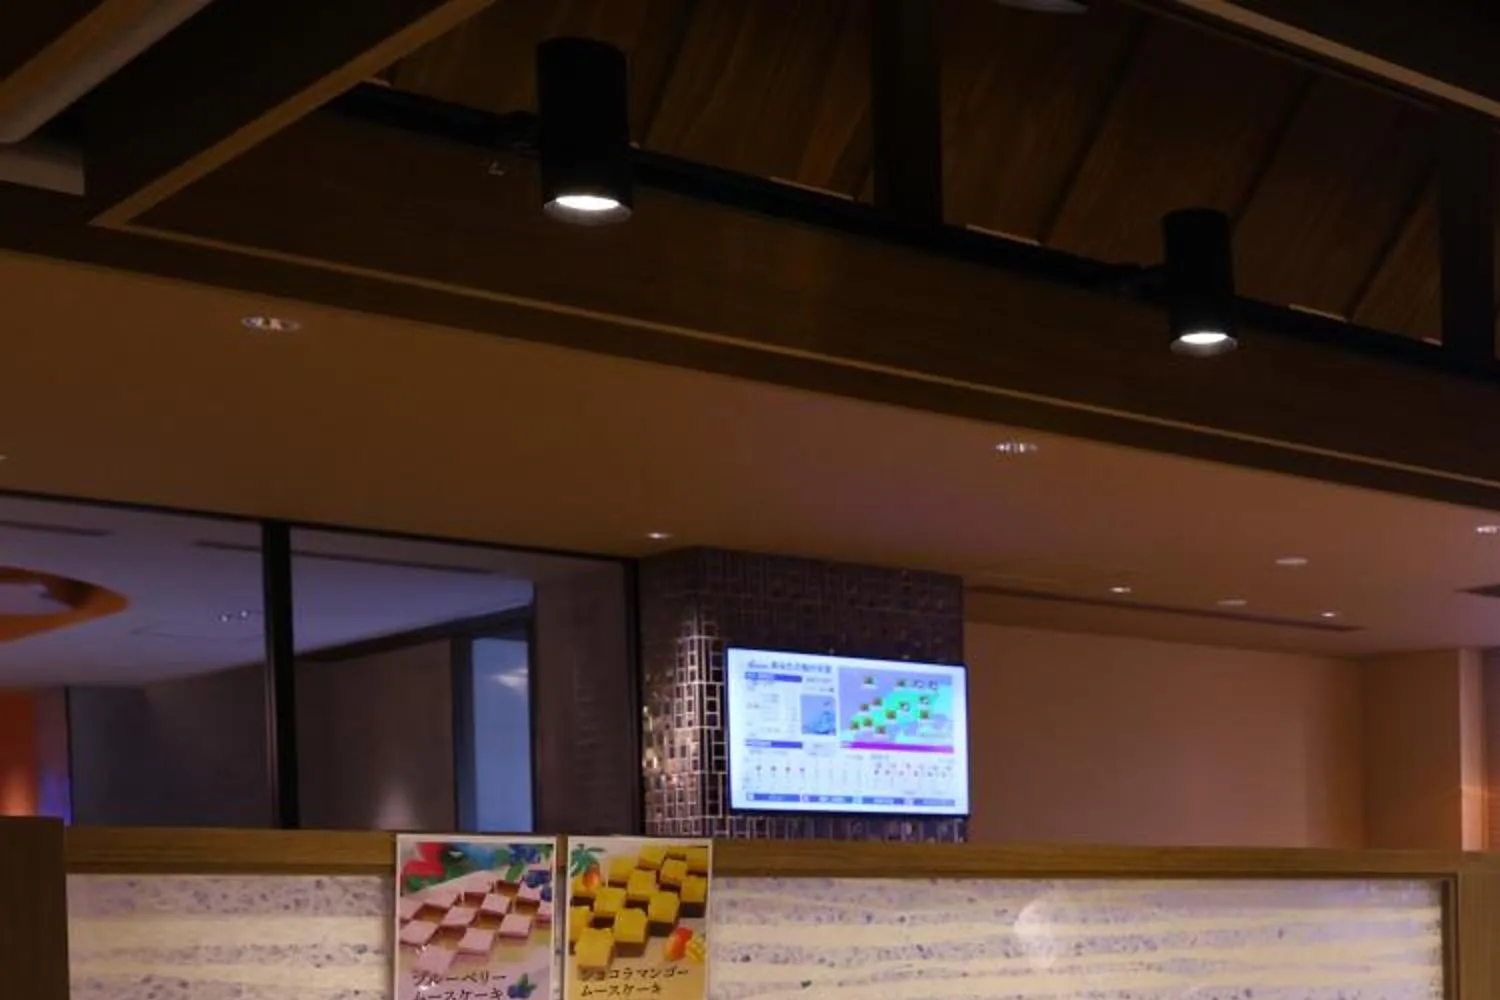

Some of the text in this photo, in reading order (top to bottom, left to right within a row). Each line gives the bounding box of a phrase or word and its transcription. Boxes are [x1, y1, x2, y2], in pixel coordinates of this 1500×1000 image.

[412, 969, 507, 987] ブルーベリー
[580, 965, 689, 981] ショコラマンゴー
[580, 983, 662, 997] ムースケーキ
